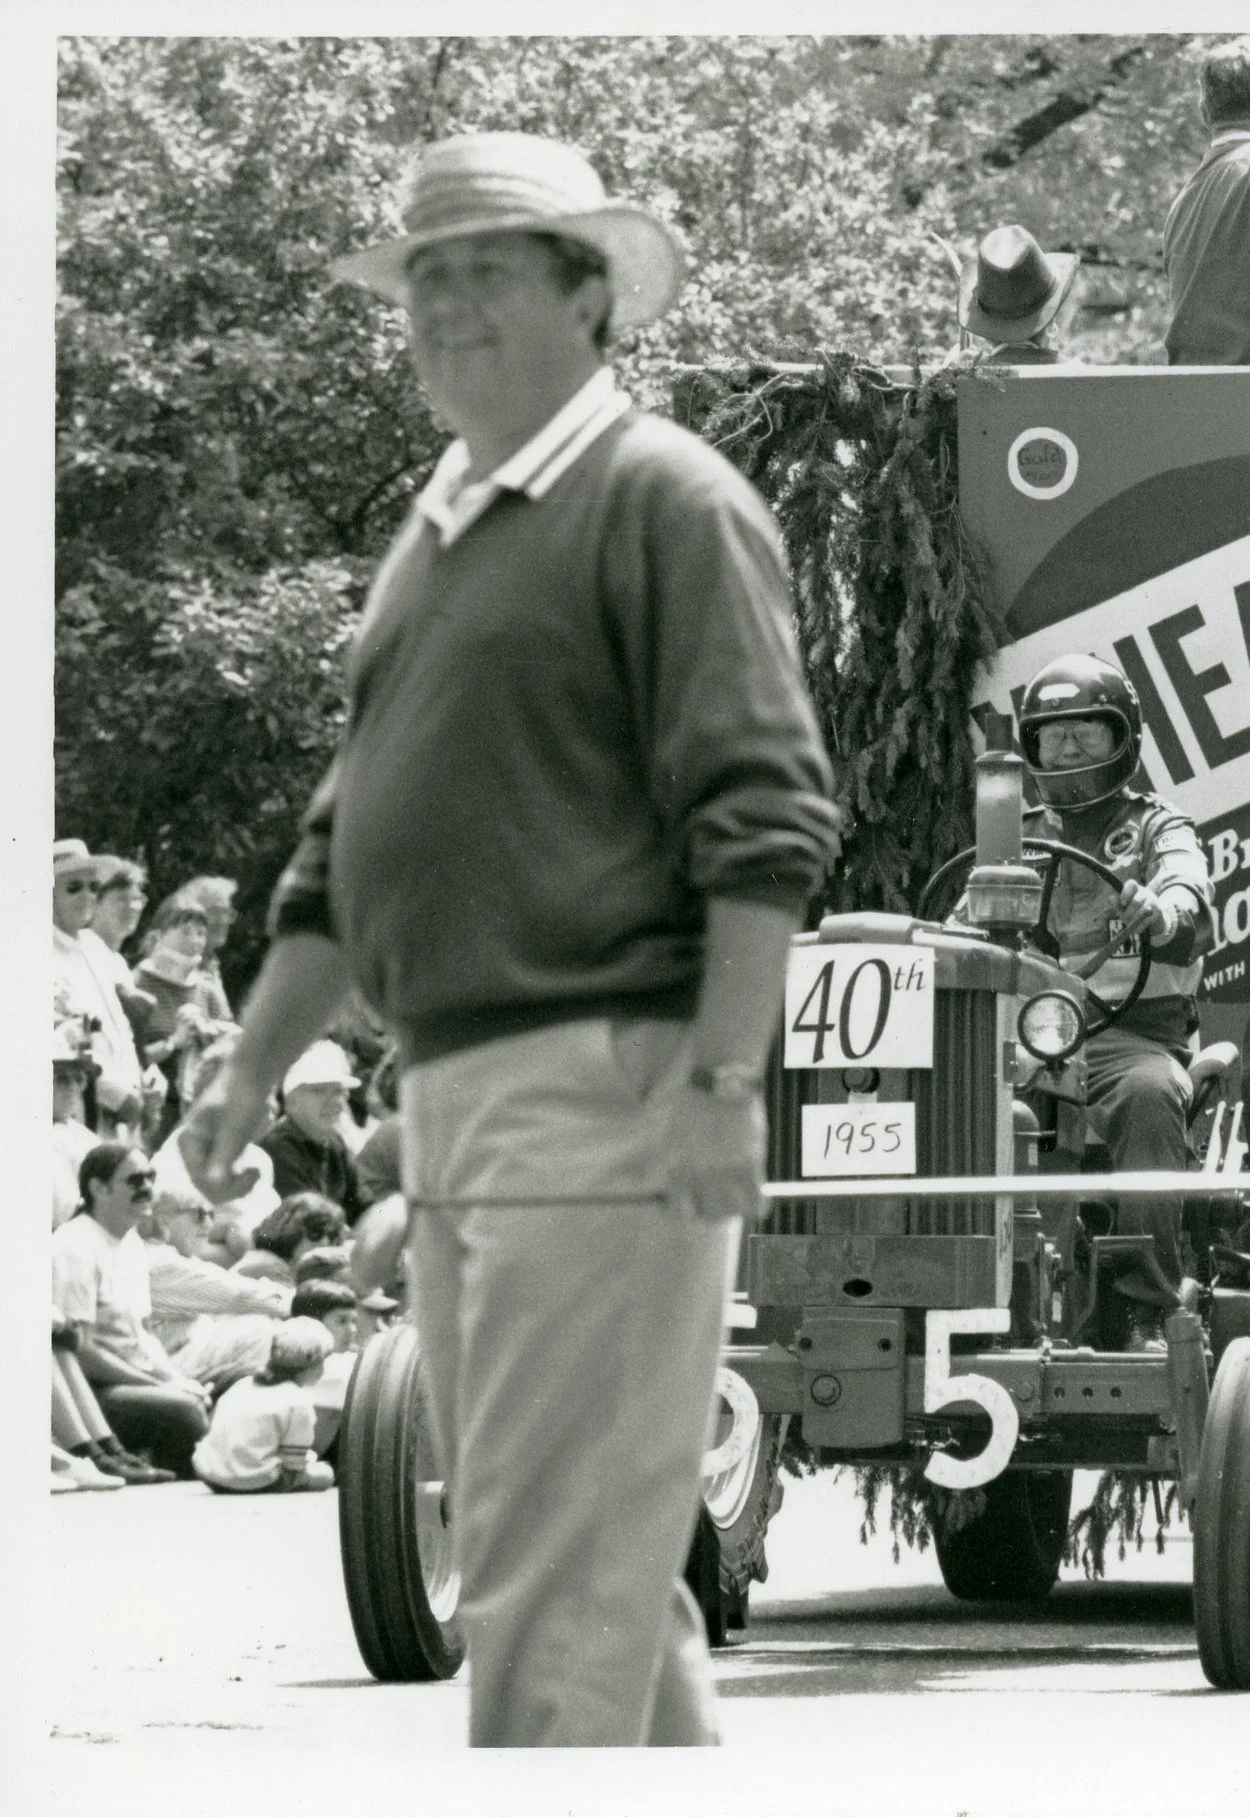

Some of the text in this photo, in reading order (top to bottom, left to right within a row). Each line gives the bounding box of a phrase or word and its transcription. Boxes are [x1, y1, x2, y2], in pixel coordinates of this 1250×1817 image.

[792, 958, 925, 1064] 40th
[1203, 960, 1246, 992] WITH
[824, 1122, 902, 1159] 1955
[925, 1308, 1019, 1489] 5
